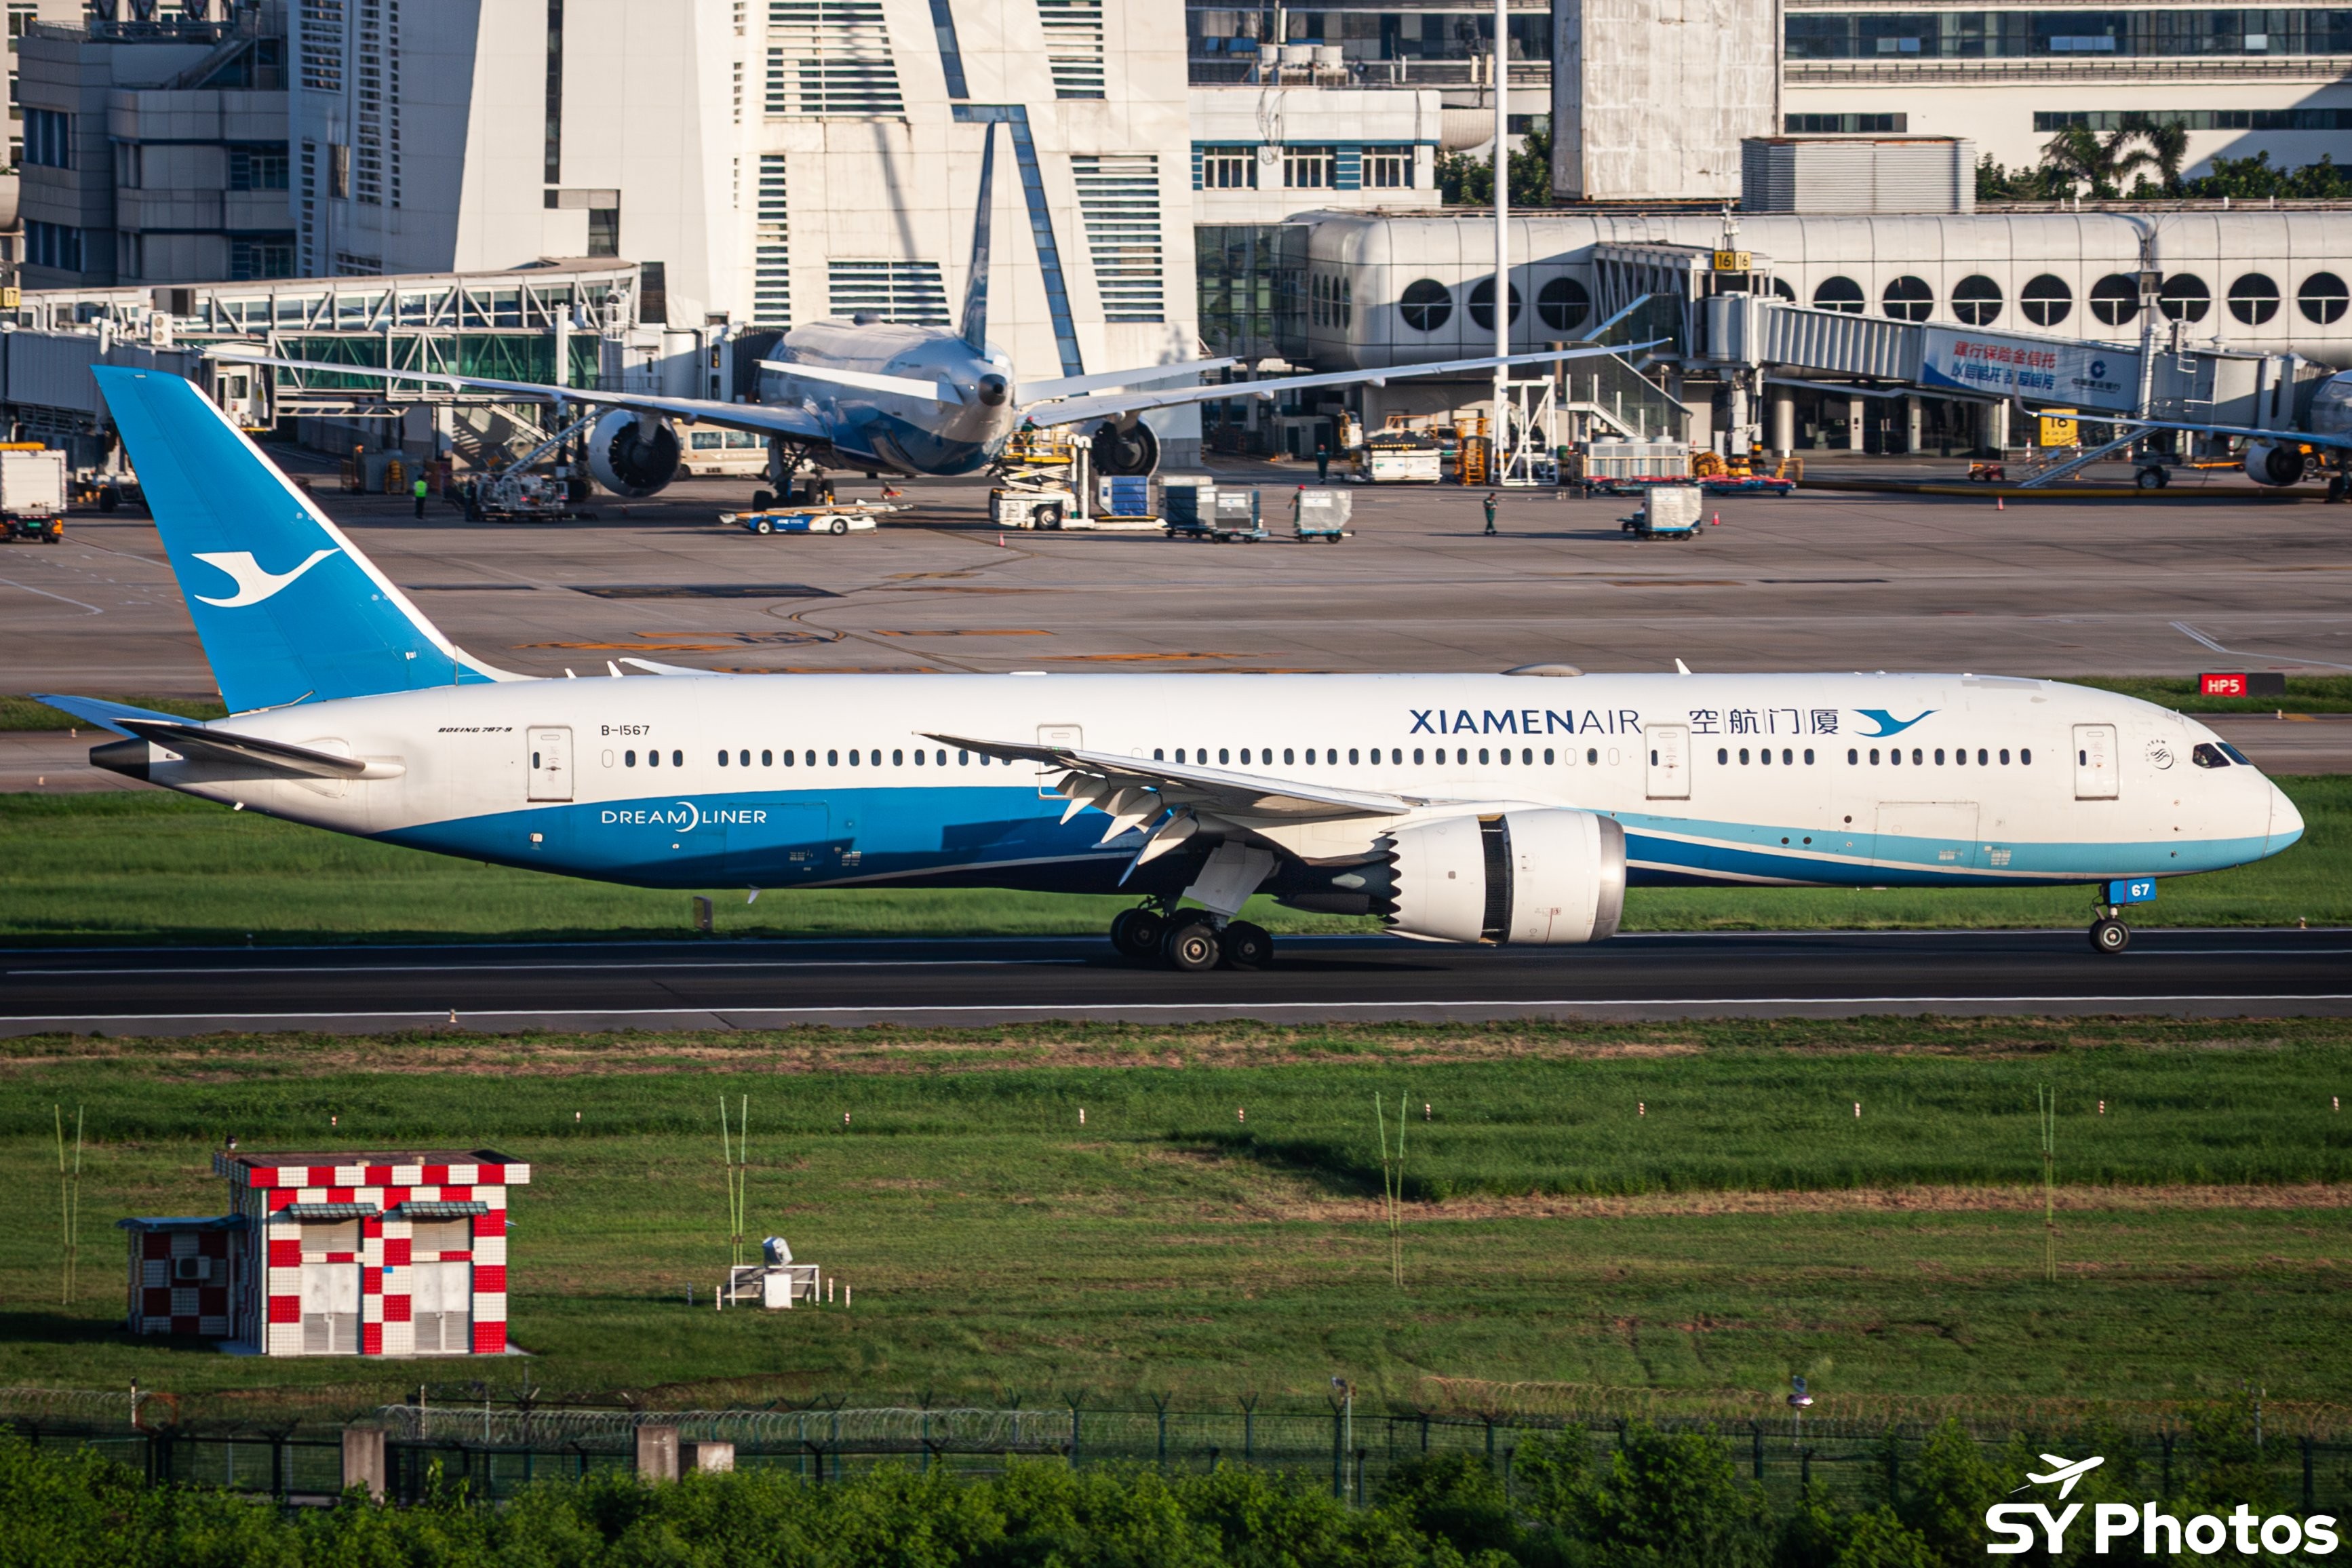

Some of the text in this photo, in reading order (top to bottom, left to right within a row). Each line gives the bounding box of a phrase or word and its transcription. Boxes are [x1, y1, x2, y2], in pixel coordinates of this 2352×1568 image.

[1719, 254, 1731, 267] 16
[1738, 254, 1748, 267] 16
[7, 290, 18, 303] 17
[1953, 340, 2056, 369] 建行保险金信托
[2208, 679, 2240, 692] HP5
[1409, 709, 1643, 734] XIAMENAIR
[602, 725, 650, 736] B-1567
[2132, 883, 2150, 897] 67
